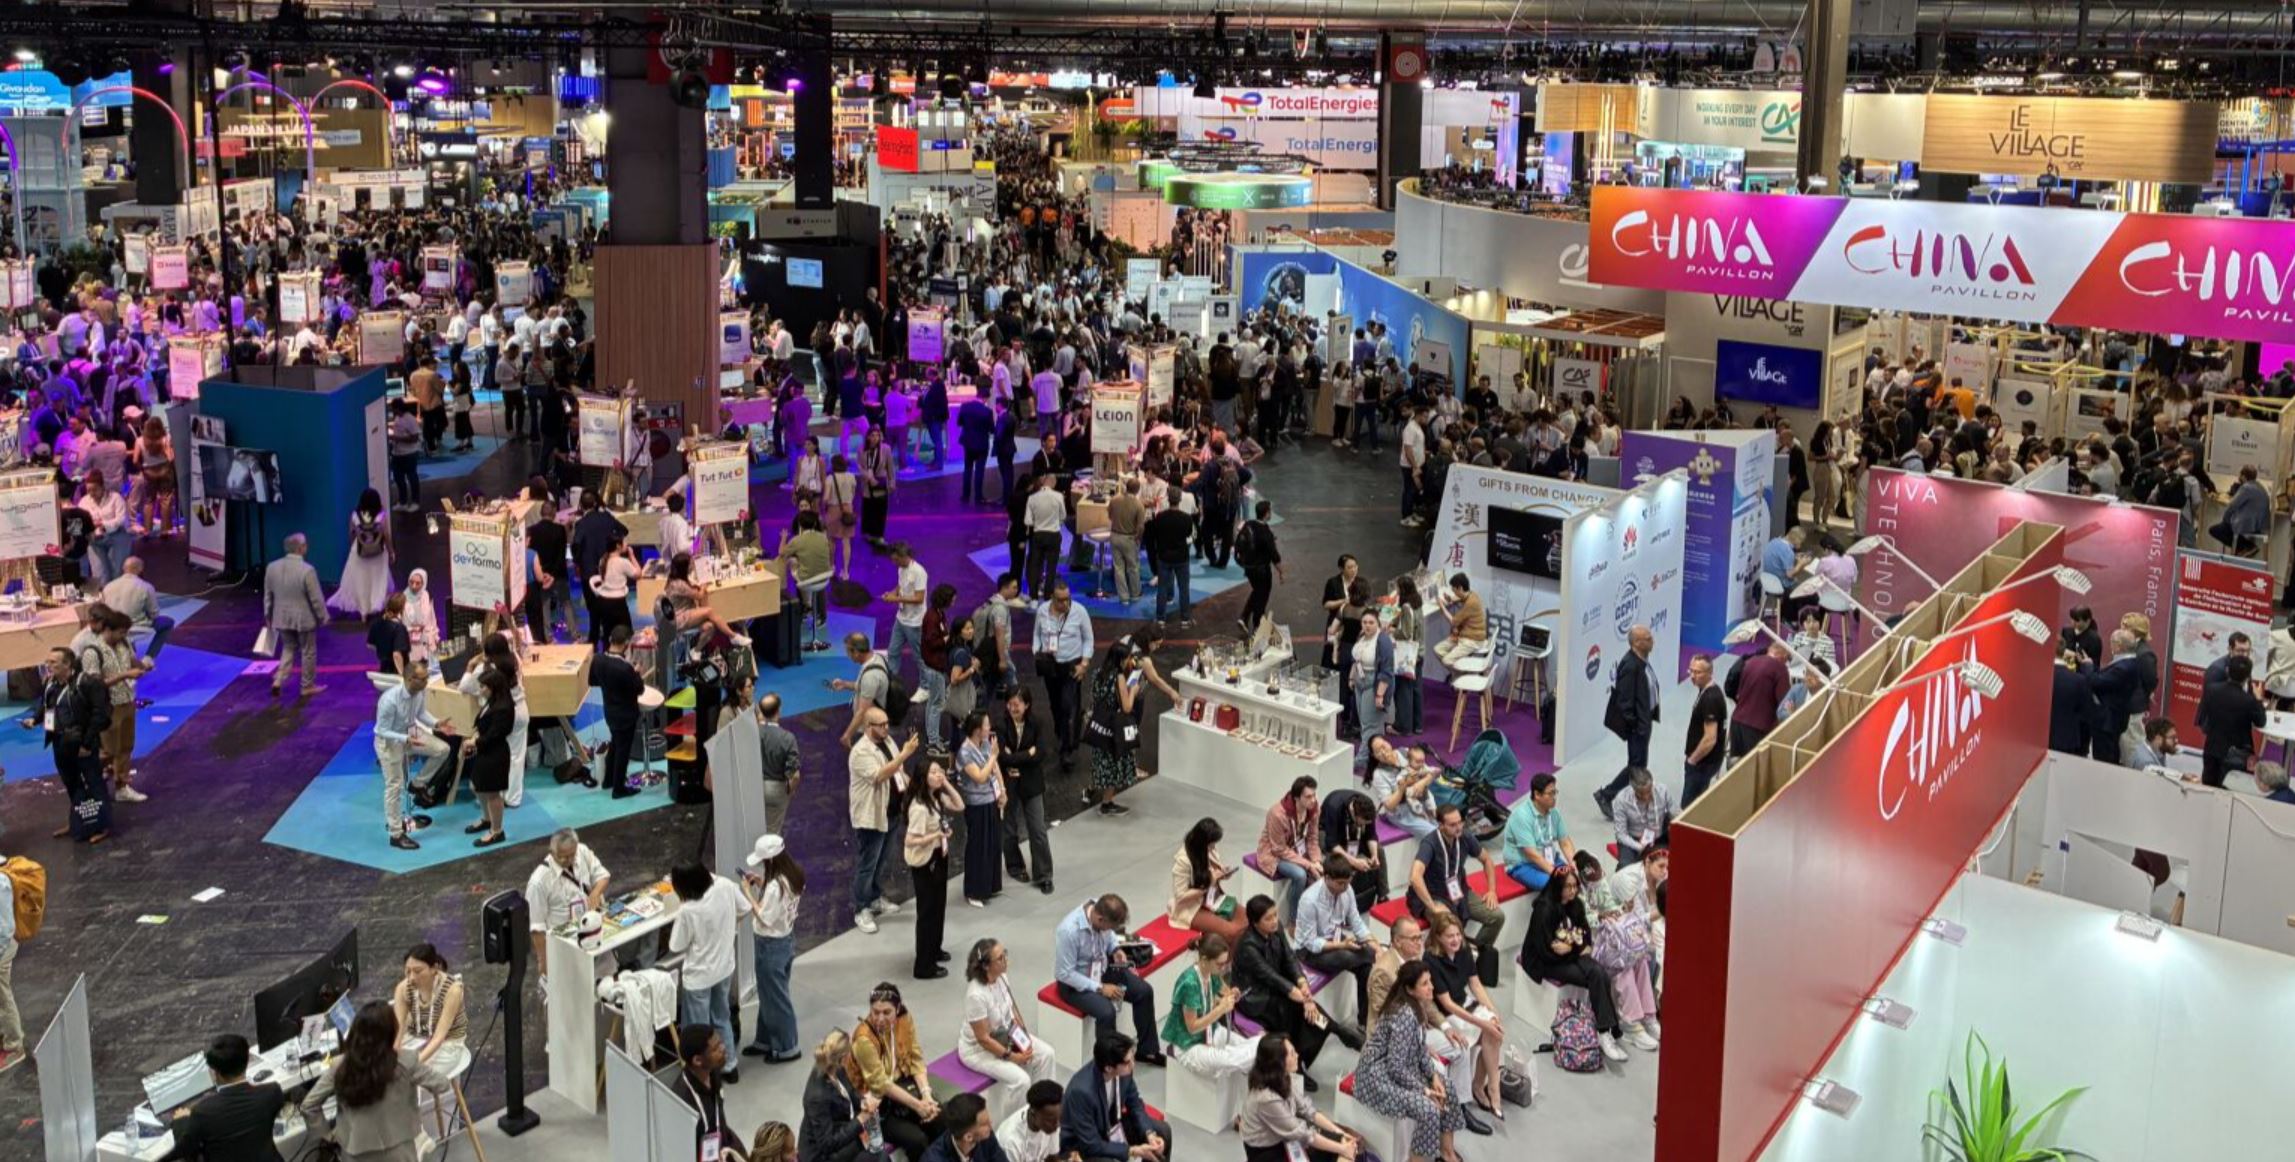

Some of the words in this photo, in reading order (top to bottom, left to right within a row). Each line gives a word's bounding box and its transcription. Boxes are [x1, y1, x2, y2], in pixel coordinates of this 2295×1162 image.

[225, 123, 265, 136] JAPAN
[2010, 105, 2031, 131] LE
[1989, 128, 2085, 158] VILLAGE
[1612, 210, 1774, 265] CHINA
[1844, 225, 2035, 285] CHINA
[1686, 265, 1774, 280] PAVILLON
[2119, 240, 2295, 305] CHIN
[1931, 284, 2036, 301] PAVILLON
[1714, 292, 1804, 324] VILLAGE
[1479, 477, 1511, 492] GIFTS
[1514, 482, 1549, 498] FROM
[1877, 478, 1938, 504] VIVA
[2148, 519, 2166, 560] Paris,
[2144, 566, 2163, 617] France
[1615, 595, 1639, 620] CCPIT
[1928, 728, 1982, 802] PAVILLON
